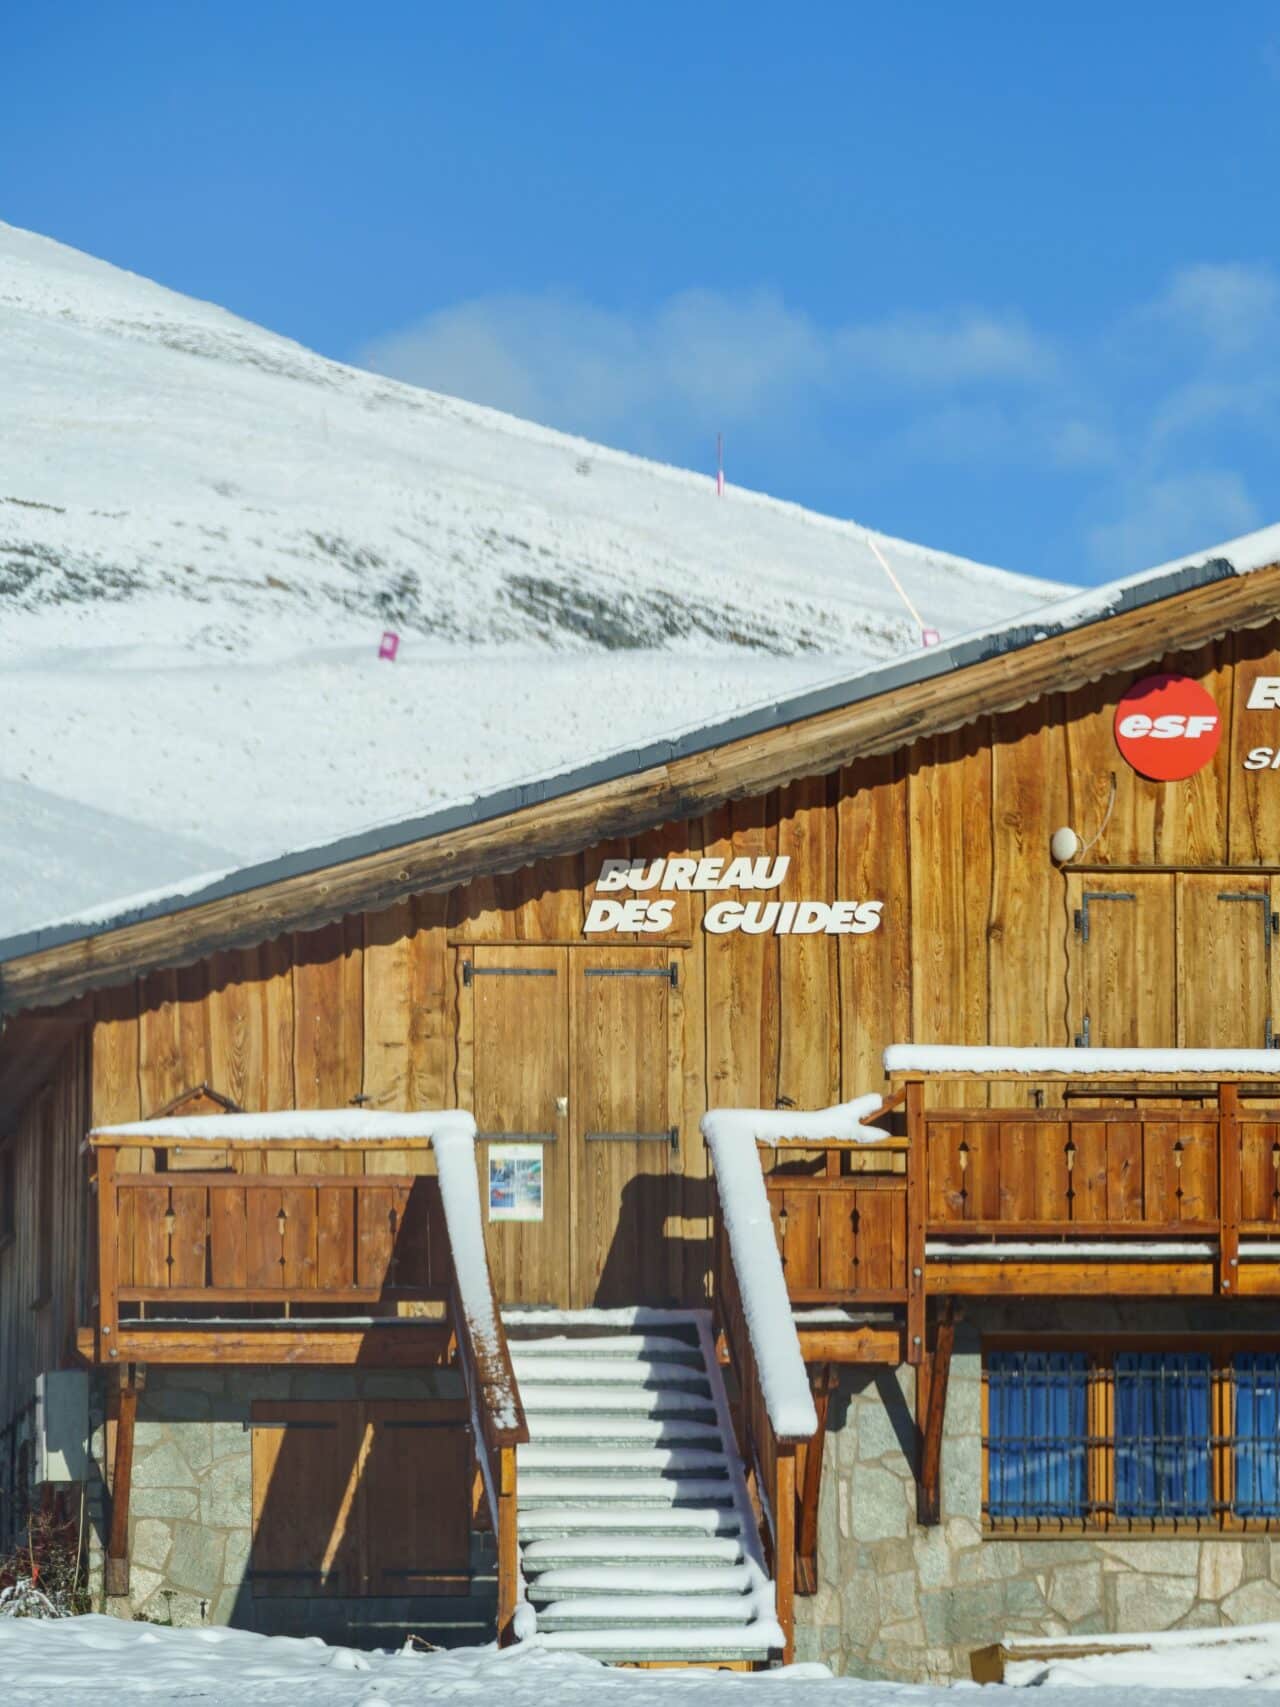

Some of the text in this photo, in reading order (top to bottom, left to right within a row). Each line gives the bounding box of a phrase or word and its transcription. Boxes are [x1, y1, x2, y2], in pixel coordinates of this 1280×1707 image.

[595, 856, 790, 891] BUREAU
[583, 899, 884, 935] DES GUIDES
